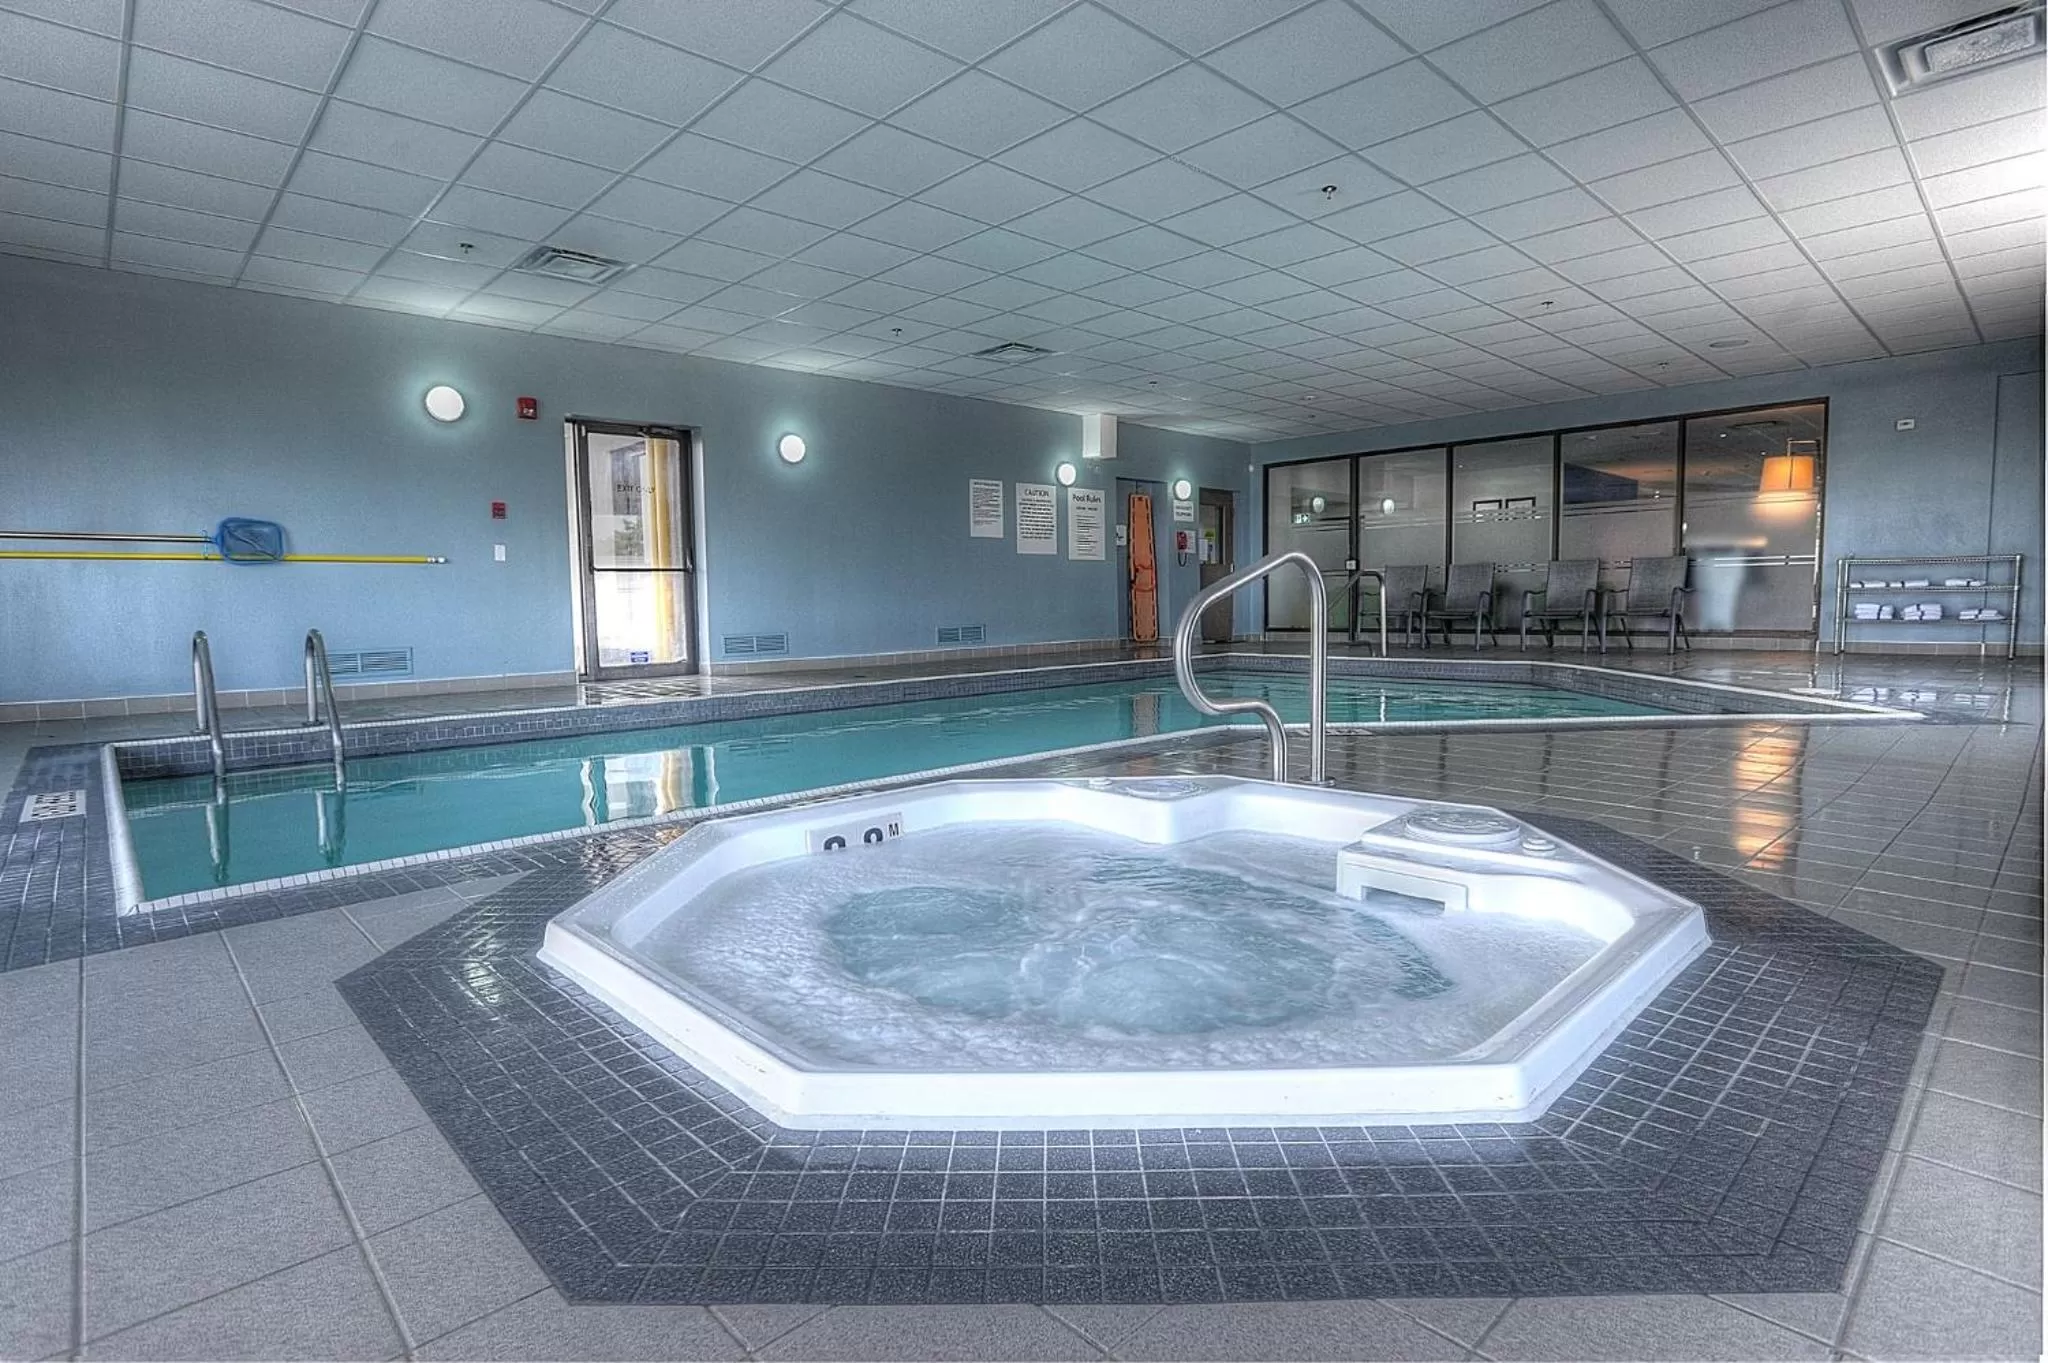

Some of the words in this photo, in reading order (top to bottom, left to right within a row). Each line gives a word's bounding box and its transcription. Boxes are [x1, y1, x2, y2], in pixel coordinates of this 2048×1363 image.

[636, 485, 655, 493] OLY
[1024, 488, 1050, 497] CAUTION
[1072, 493, 1085, 502] Pool
[888, 823, 899, 837] M
